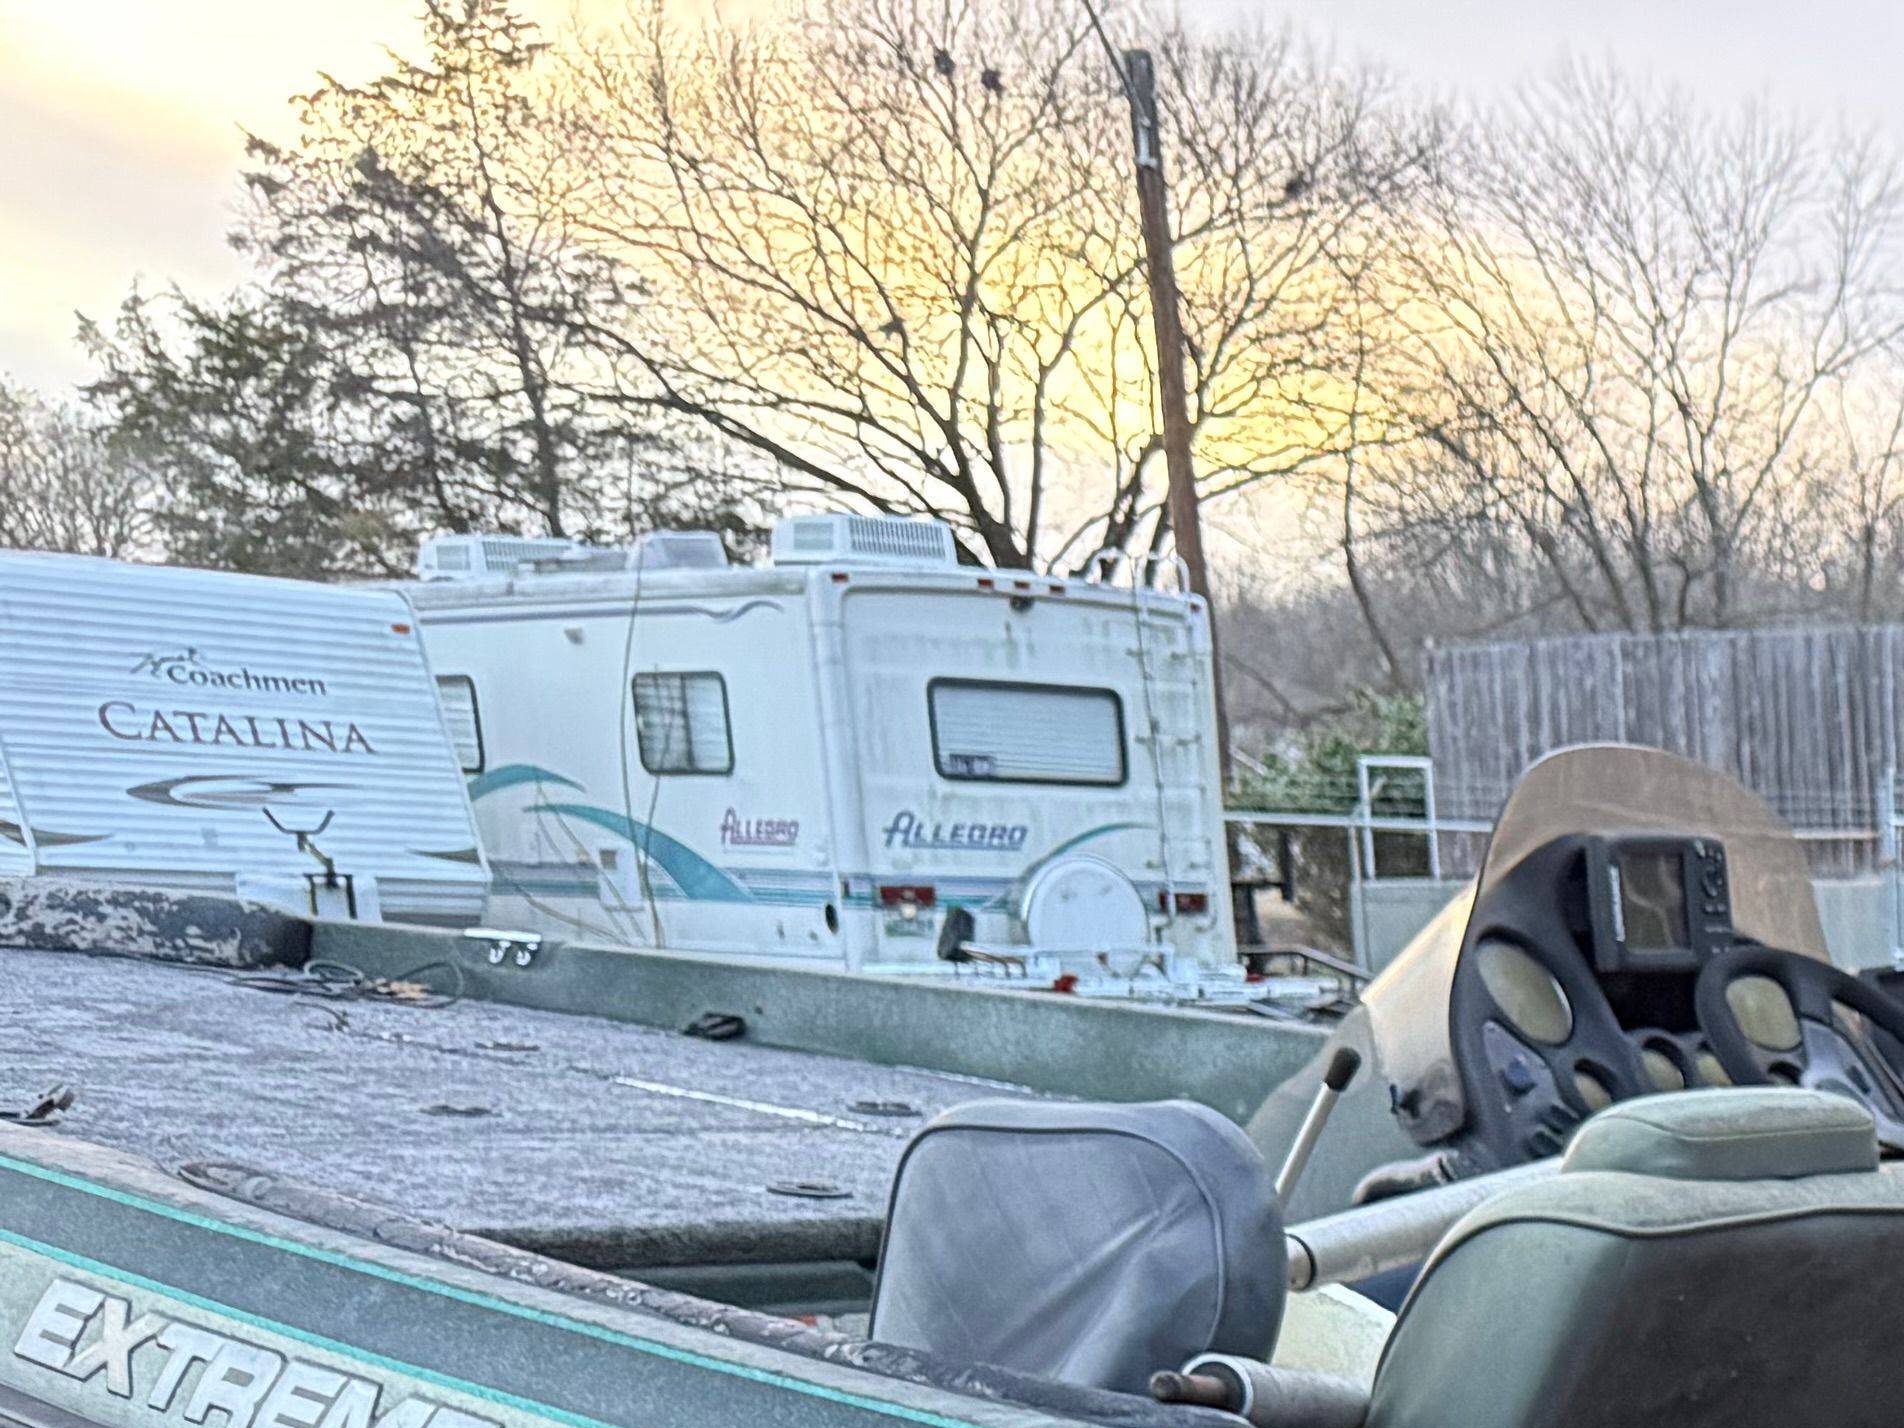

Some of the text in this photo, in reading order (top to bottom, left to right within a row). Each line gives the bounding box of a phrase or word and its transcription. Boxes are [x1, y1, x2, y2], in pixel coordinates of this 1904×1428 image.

[167, 665, 327, 696] Coachmen
[98, 700, 378, 754] CATALINA
[884, 810, 1028, 850] ALLEGRO
